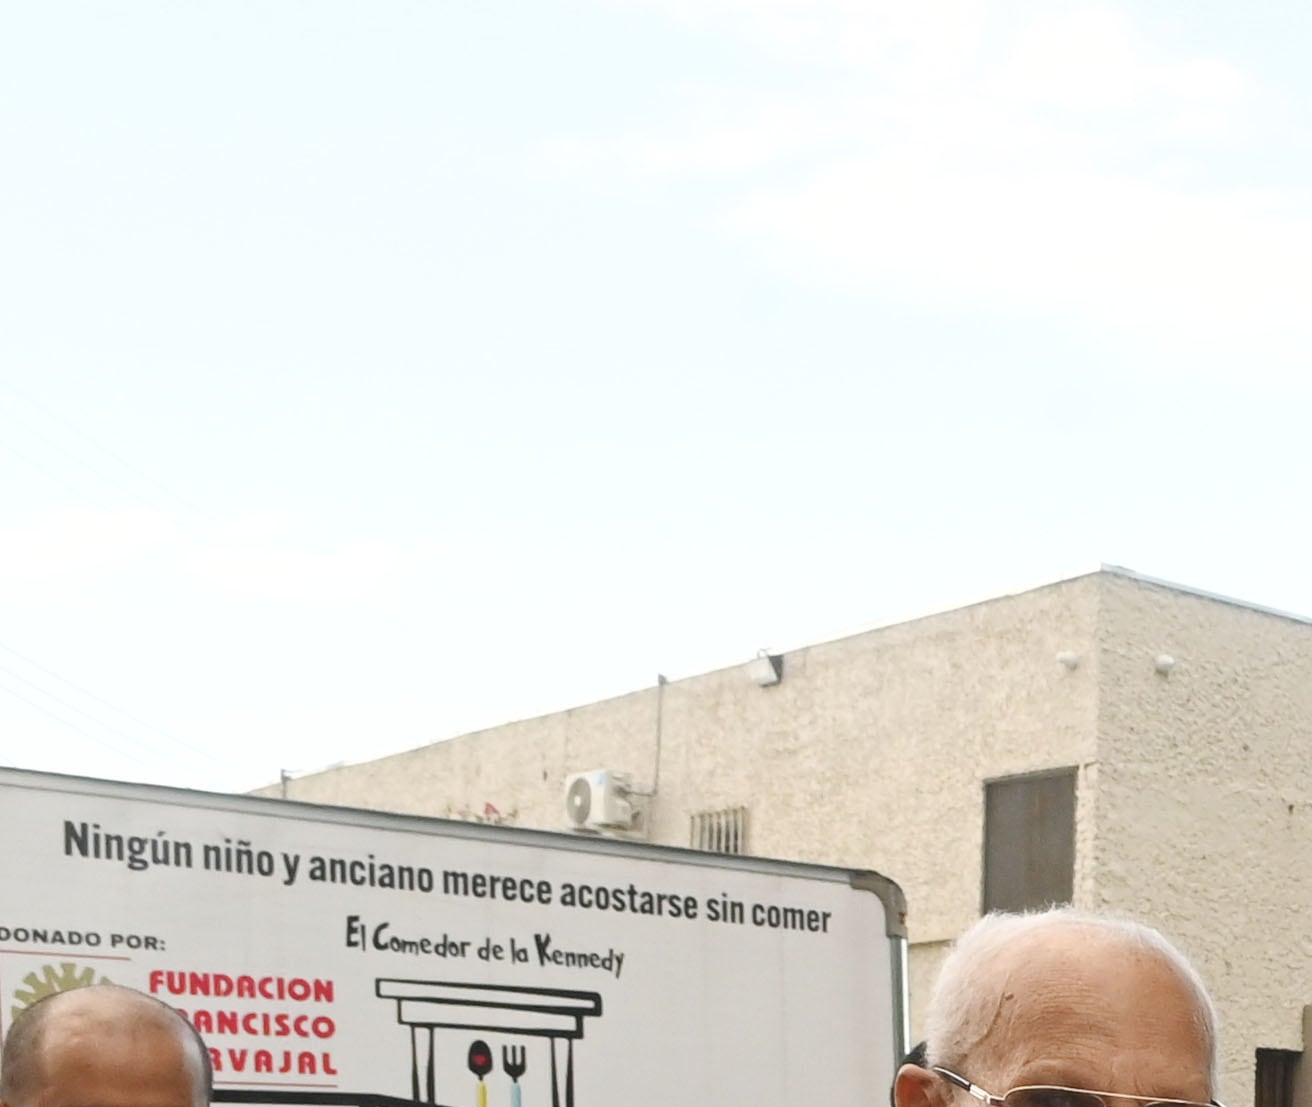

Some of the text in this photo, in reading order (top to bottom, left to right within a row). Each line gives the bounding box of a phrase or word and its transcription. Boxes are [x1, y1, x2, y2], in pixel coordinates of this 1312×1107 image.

[64, 820, 832, 933] Ningún niño y anciano merece acostarse sin comer
[111, 933, 167, 951] POR:
[346, 915, 625, 979] El Comedor de la Kennedy
[149, 970, 334, 1003] FUNDACION
[178, 1009, 336, 1039] ANCISCO
[209, 1047, 338, 1075] RVAJAL
